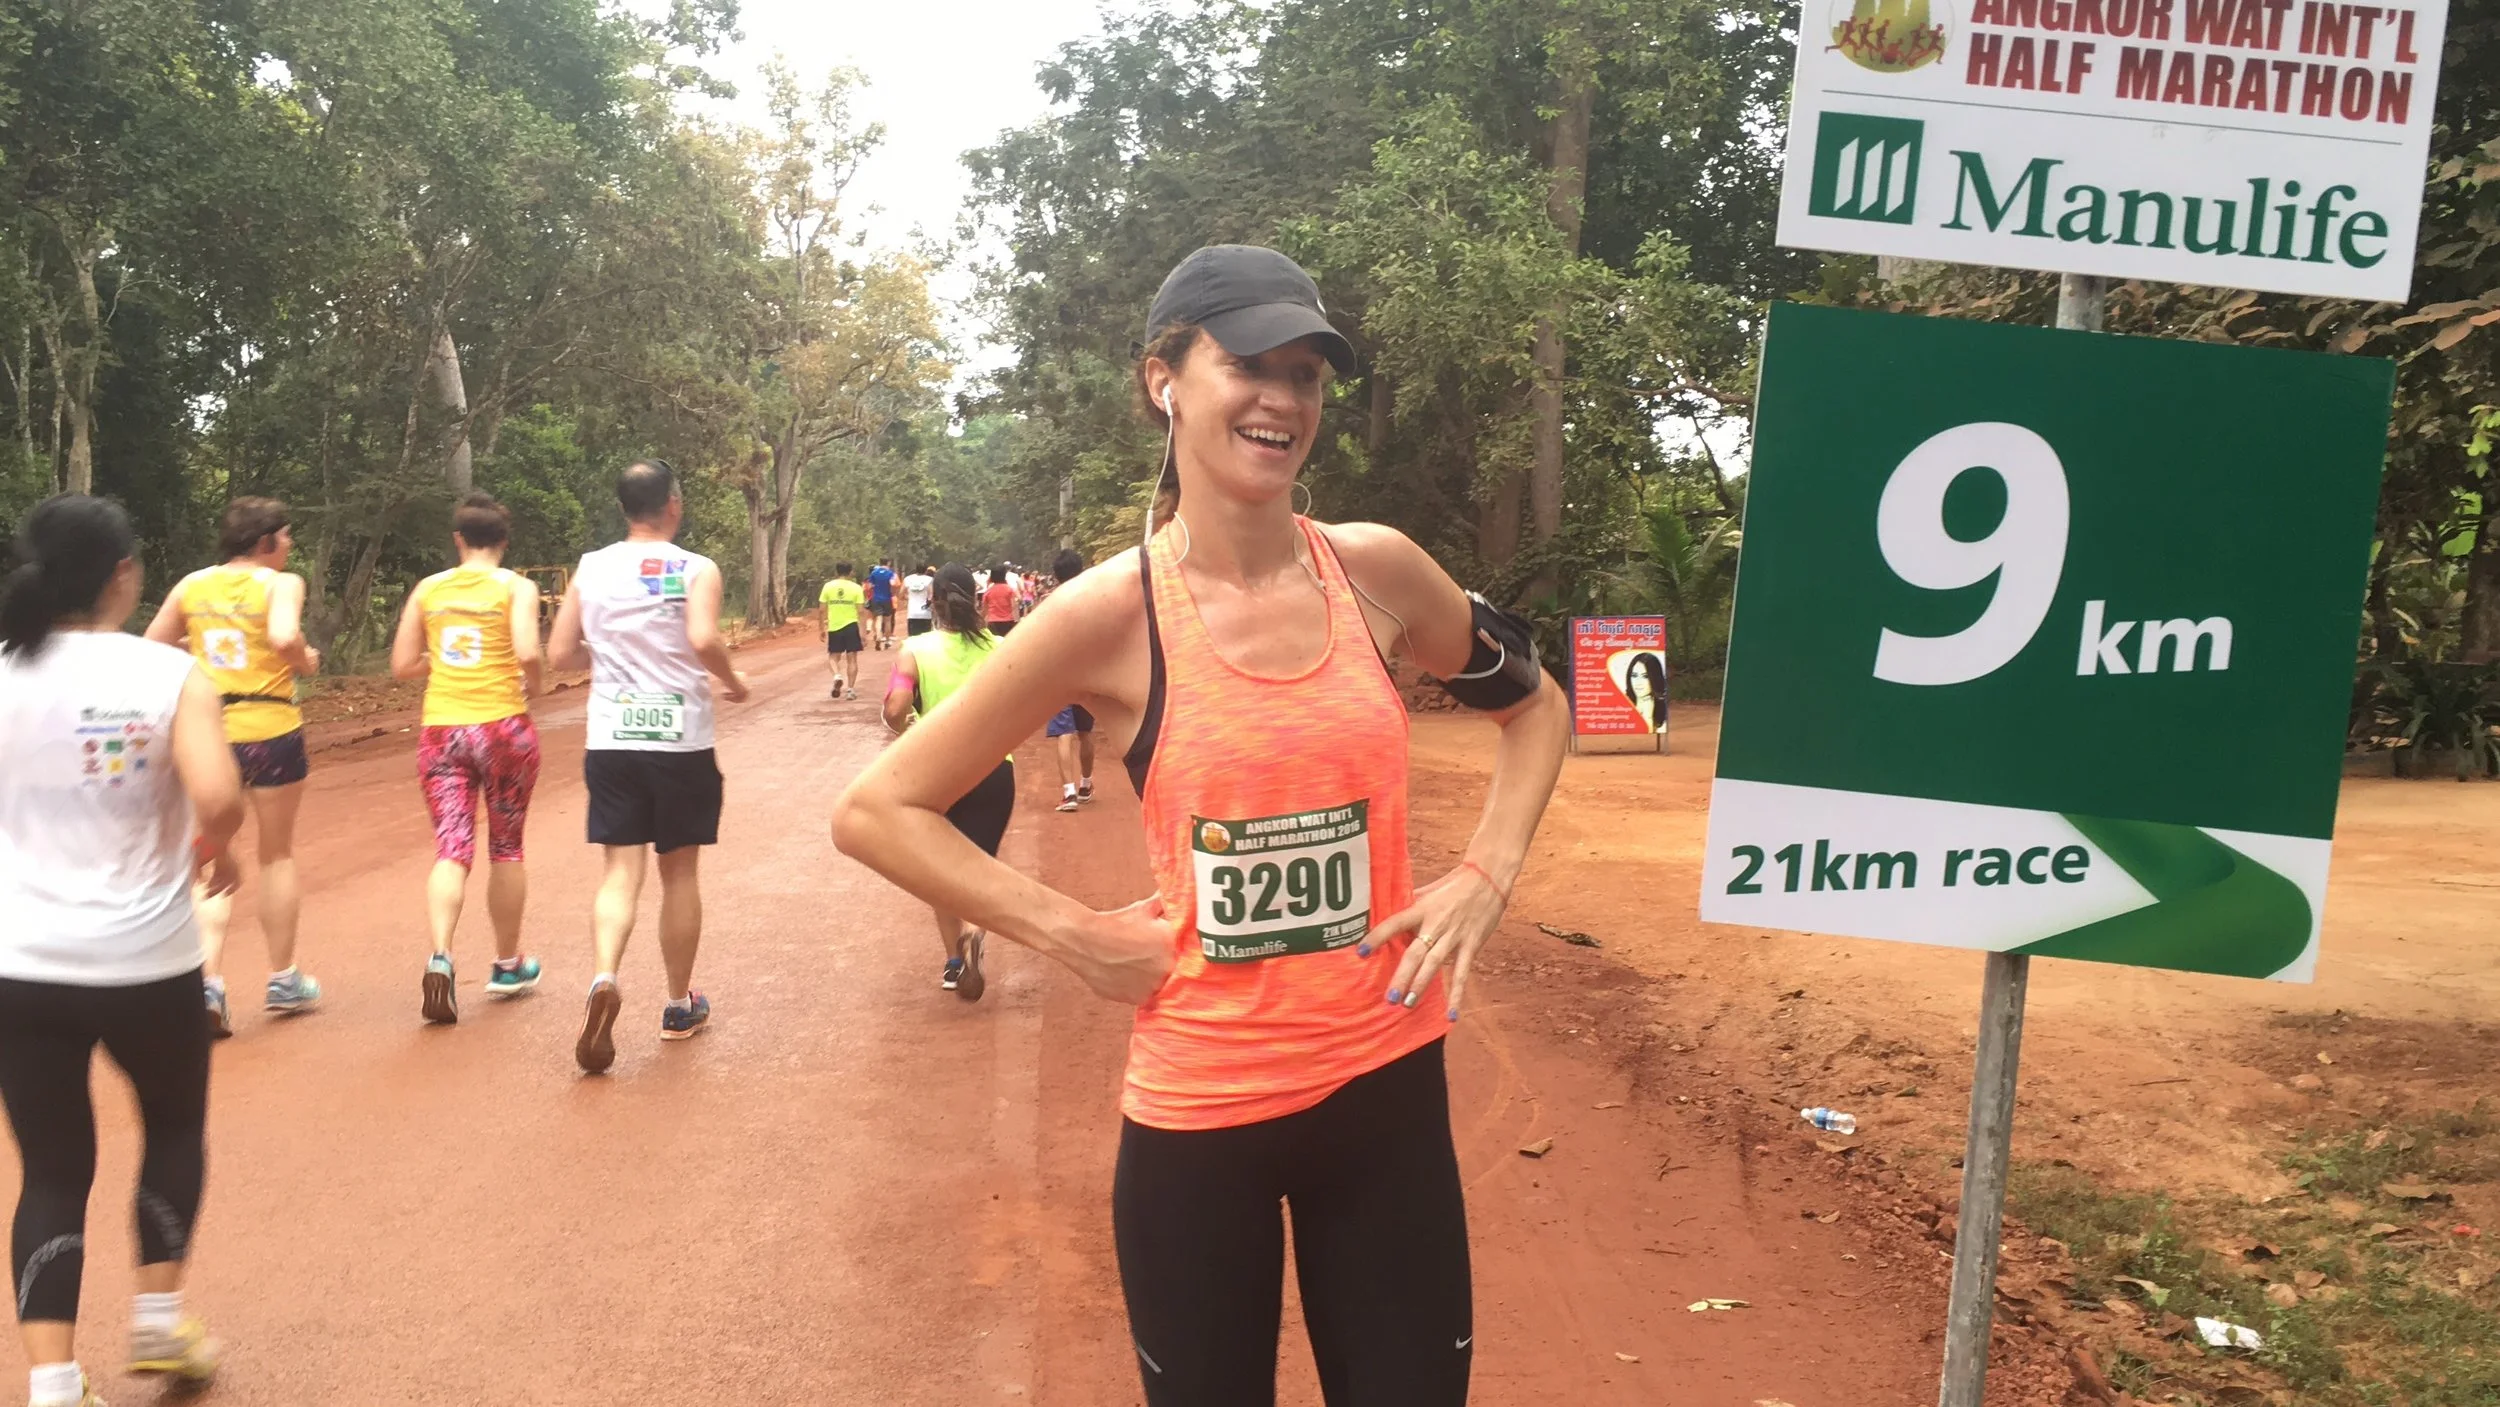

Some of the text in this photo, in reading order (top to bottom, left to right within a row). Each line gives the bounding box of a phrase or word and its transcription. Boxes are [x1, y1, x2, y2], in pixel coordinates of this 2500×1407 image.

[2184, 0, 2294, 51] WAT
[2297, 1, 2419, 64] INT'L
[1966, 32, 2414, 125] HALF MARATHON
[1941, 149, 2389, 269] Manulife
[1872, 421, 2234, 686] 9 km
[622, 708, 674, 728] 0905
[1234, 836, 1267, 851] HALF
[1267, 826, 1336, 847] MARATHON
[1245, 817, 1298, 835] ANGKOR
[1298, 813, 1327, 829] WAT
[1211, 850, 1353, 926] 3290
[1725, 839, 2091, 896] 21km race
[1216, 939, 1288, 958] Manulife
